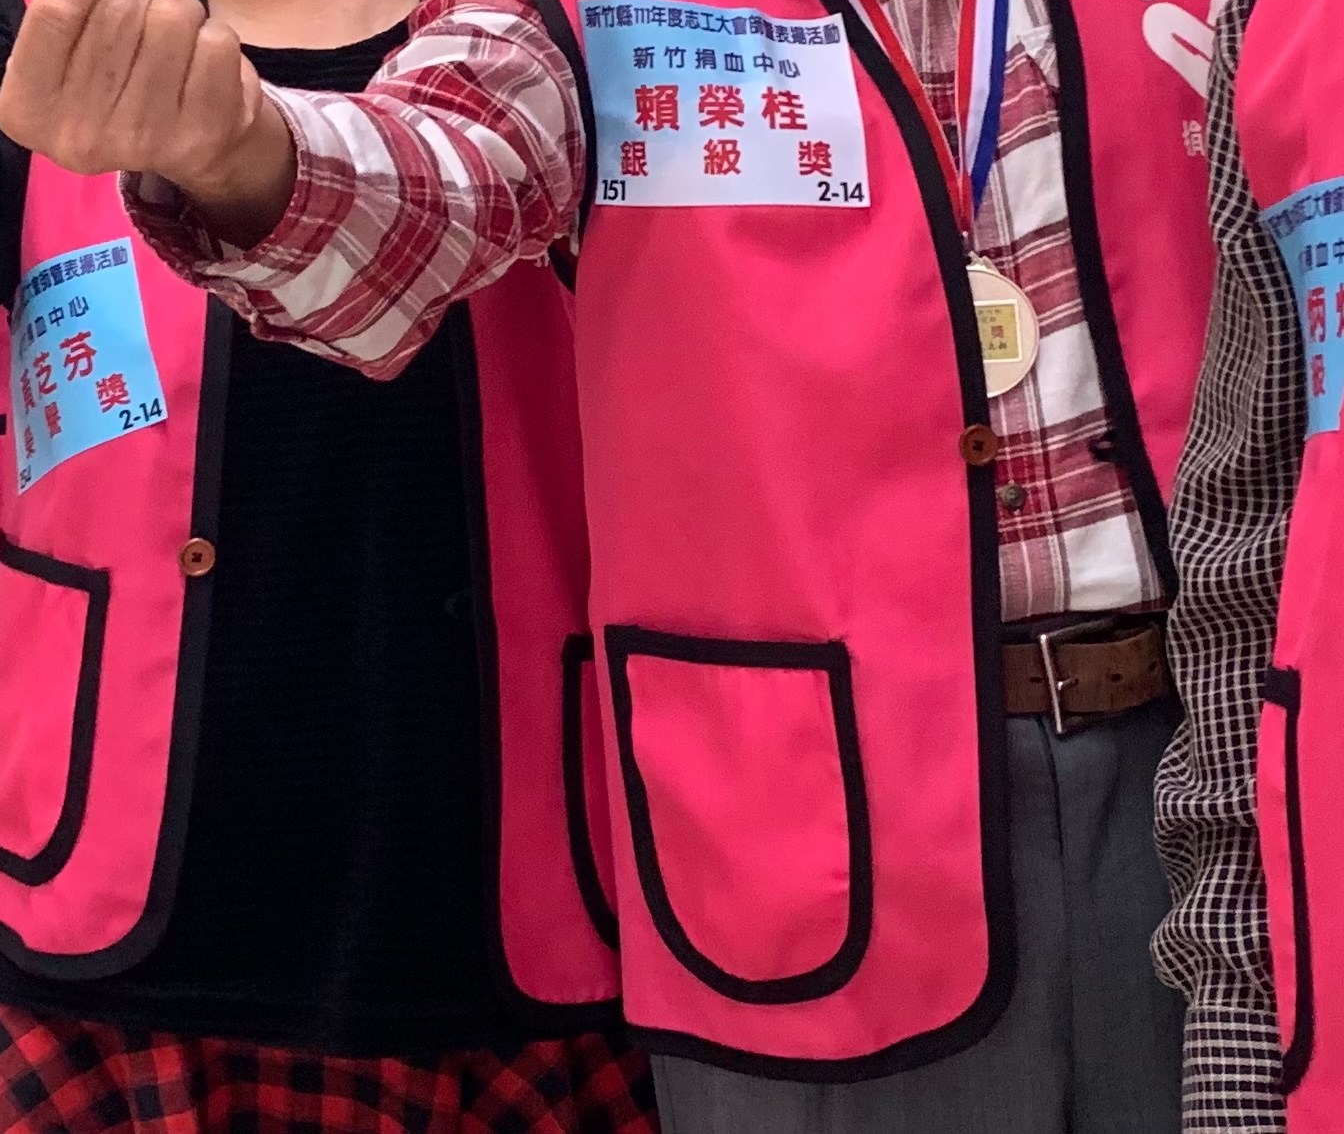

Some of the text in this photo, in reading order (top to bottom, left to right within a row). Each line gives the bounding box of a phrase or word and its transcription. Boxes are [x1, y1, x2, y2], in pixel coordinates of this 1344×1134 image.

[633, 46, 802, 78] 新竹捐血中心
[634, 84, 808, 131] 賴榮桂
[620, 139, 833, 177] 銀級獎
[601, 180, 865, 203] 151 2-14
[119, 398, 163, 430] 2-14
